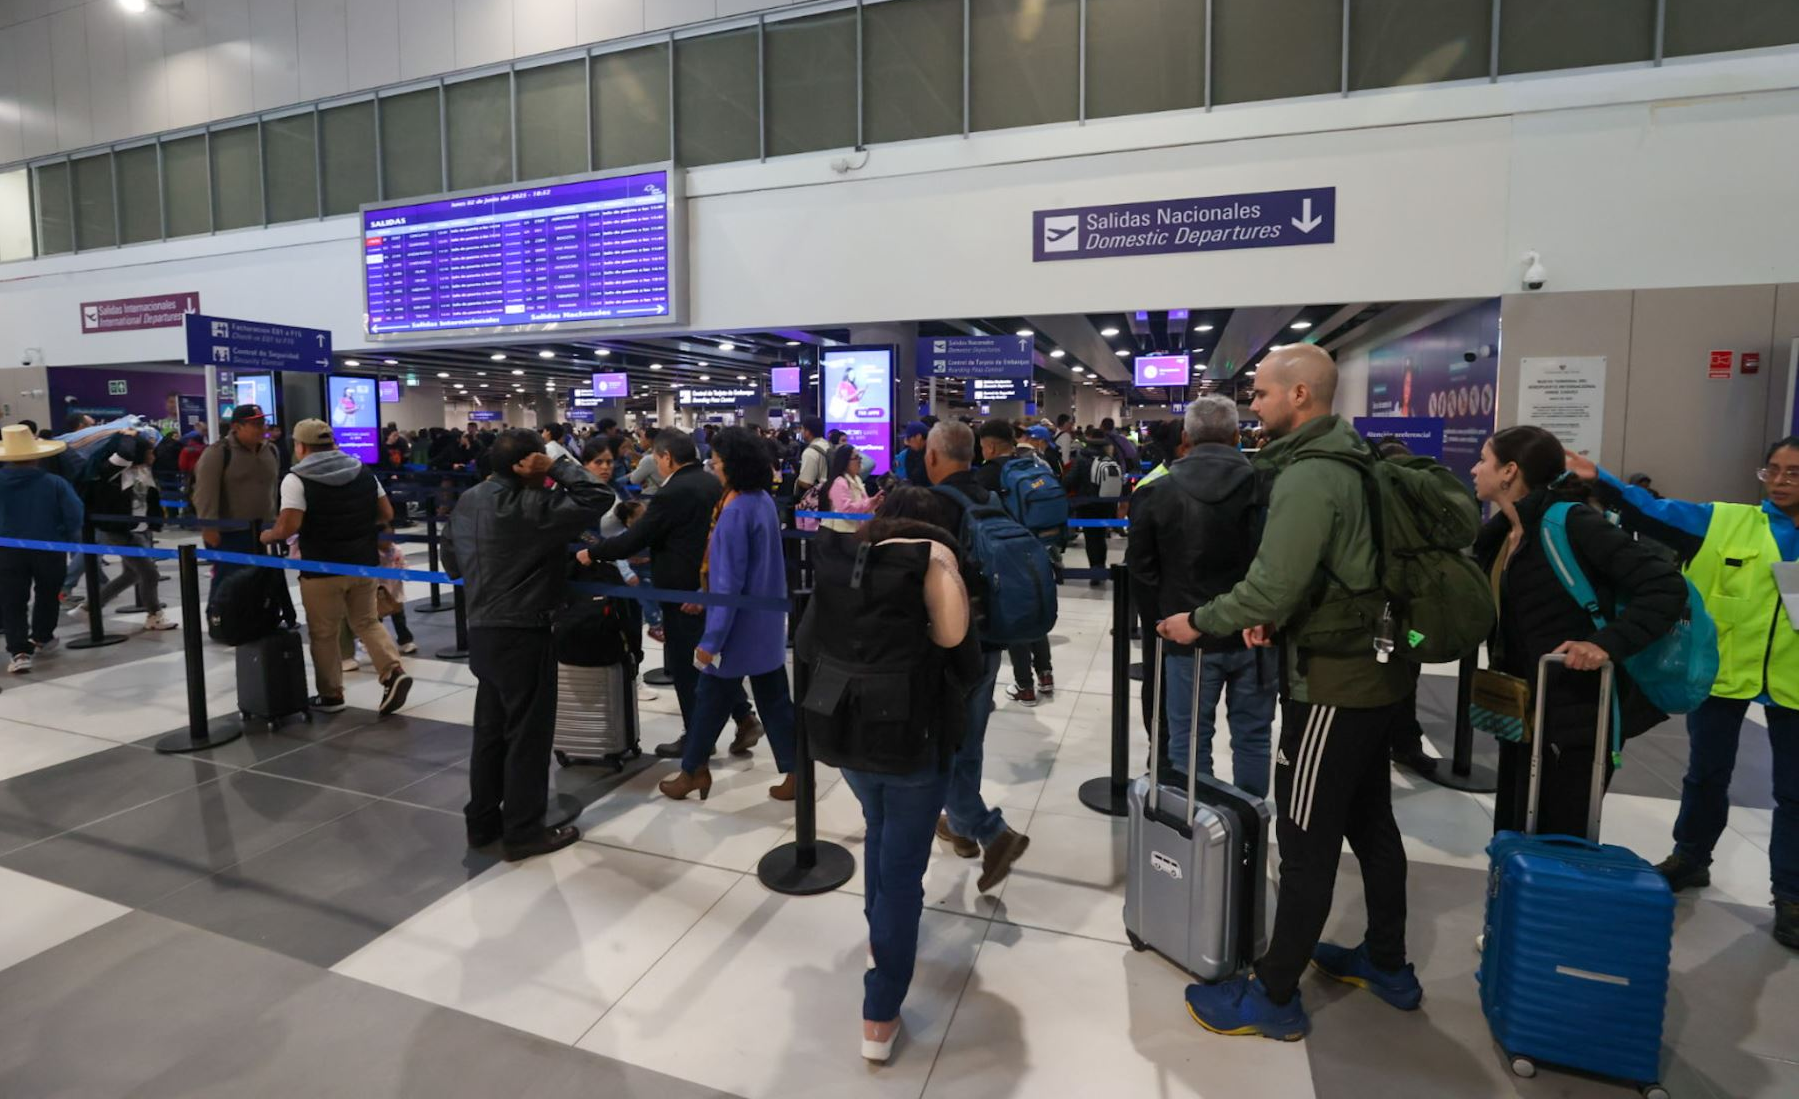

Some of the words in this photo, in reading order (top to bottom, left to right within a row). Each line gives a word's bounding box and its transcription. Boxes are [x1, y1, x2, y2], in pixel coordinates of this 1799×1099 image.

[1086, 211, 1150, 230] Salidas
[1157, 202, 1261, 225] Nacionales
[371, 218, 406, 228] SALIDAS
[1086, 230, 1169, 250] Domestic
[1174, 223, 1282, 246] Departures
[99, 306, 122, 315] Salidas
[124, 300, 176, 313] Internacionales
[100, 314, 142, 327] International
[143, 313, 183, 324] Departures
[531, 313, 560, 321] Salidas
[563, 309, 611, 318] Nacionales
[439, 318, 499, 326] Internacionales
[232, 347, 256, 356] Control
[268, 350, 299, 360] Seguridad
[233, 356, 260, 365] Security
